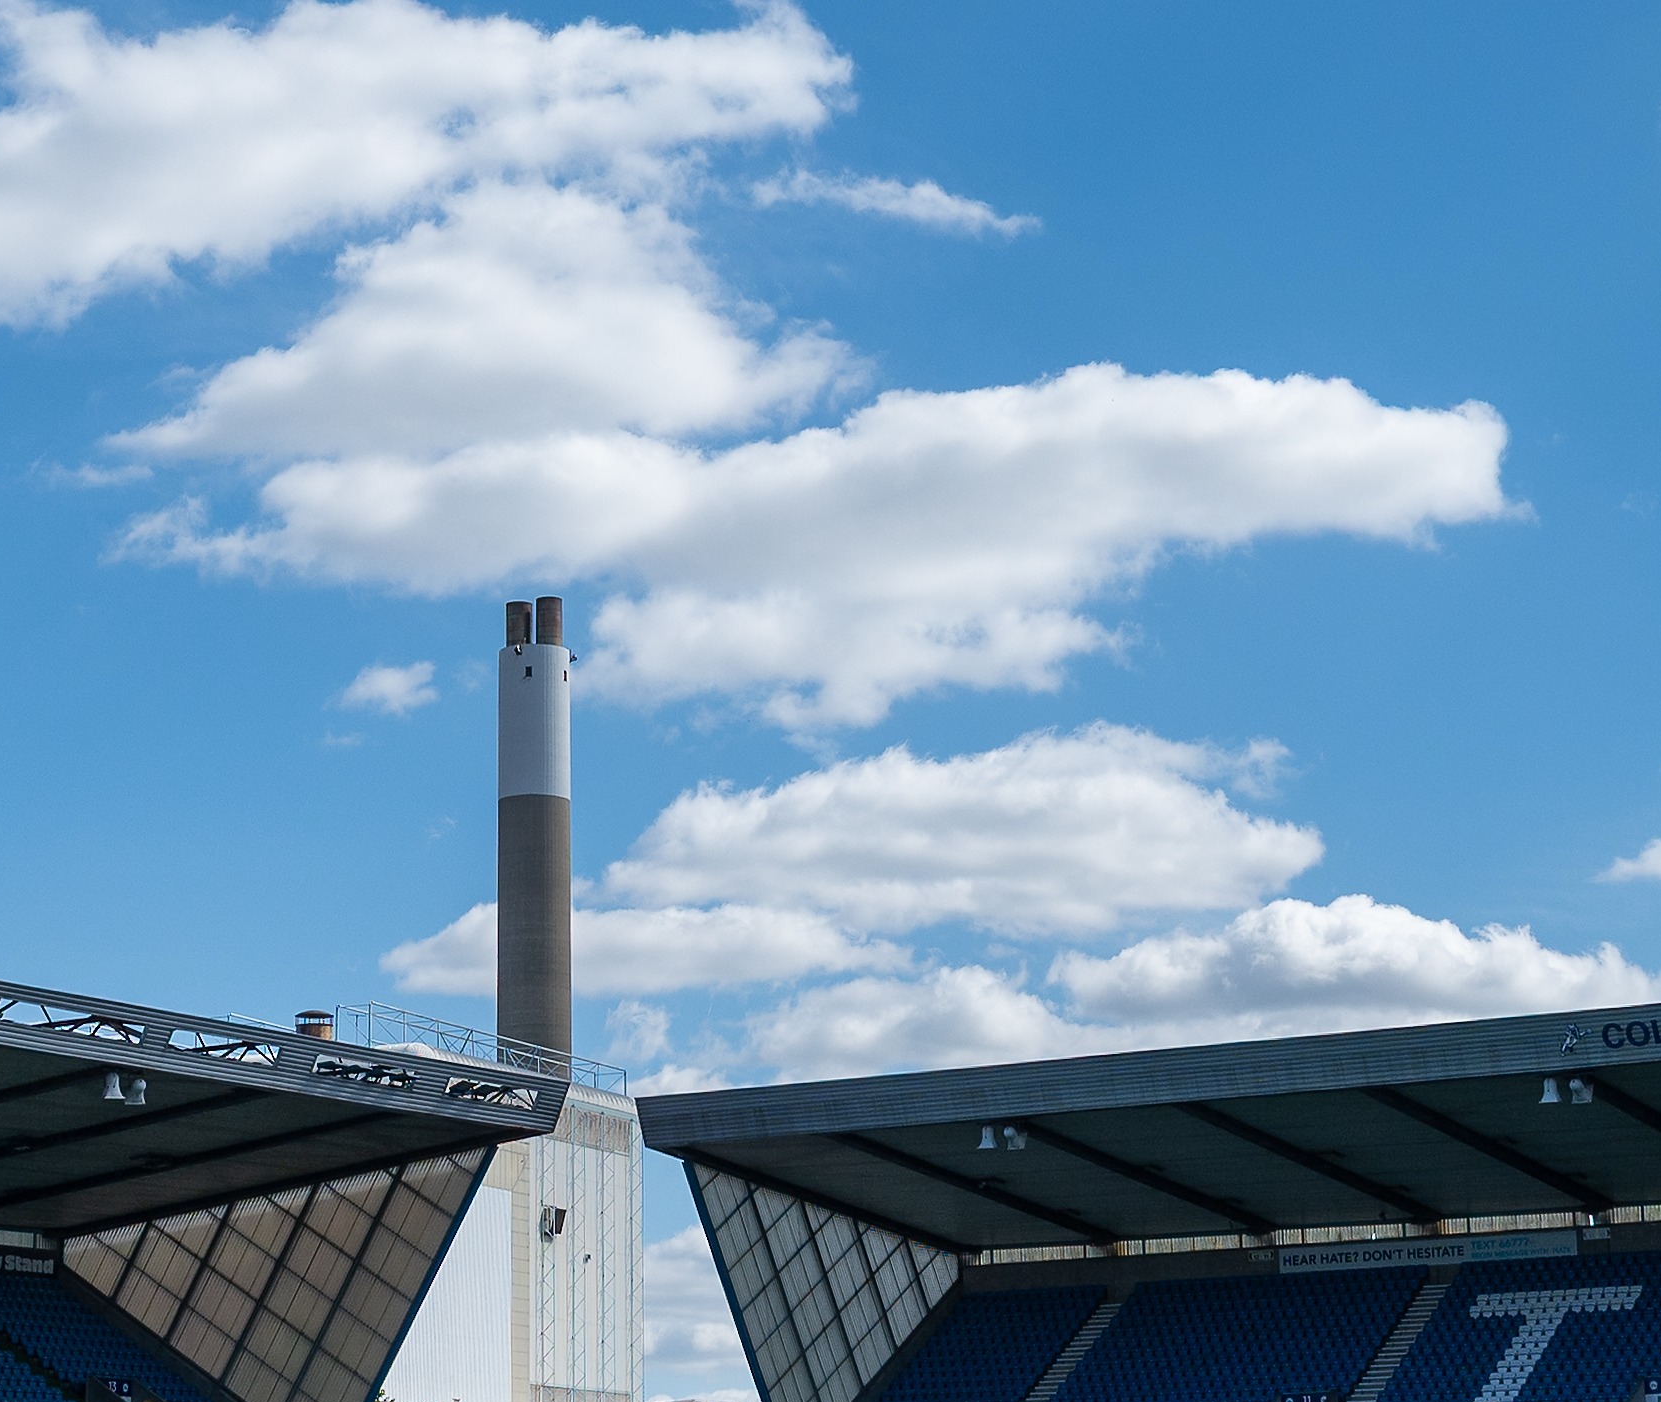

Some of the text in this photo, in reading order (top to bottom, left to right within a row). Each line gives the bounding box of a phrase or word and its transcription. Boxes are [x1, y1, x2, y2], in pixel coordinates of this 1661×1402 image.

[1470, 1240, 1494, 1249] TEXT
[4, 1255, 54, 1274] Stand
[1282, 1255, 1316, 1267] HEAR
[1320, 1251, 1359, 1265] HATE?
[1362, 1248, 1402, 1262] DON'T
[1406, 1245, 1464, 1260] HESITATE
